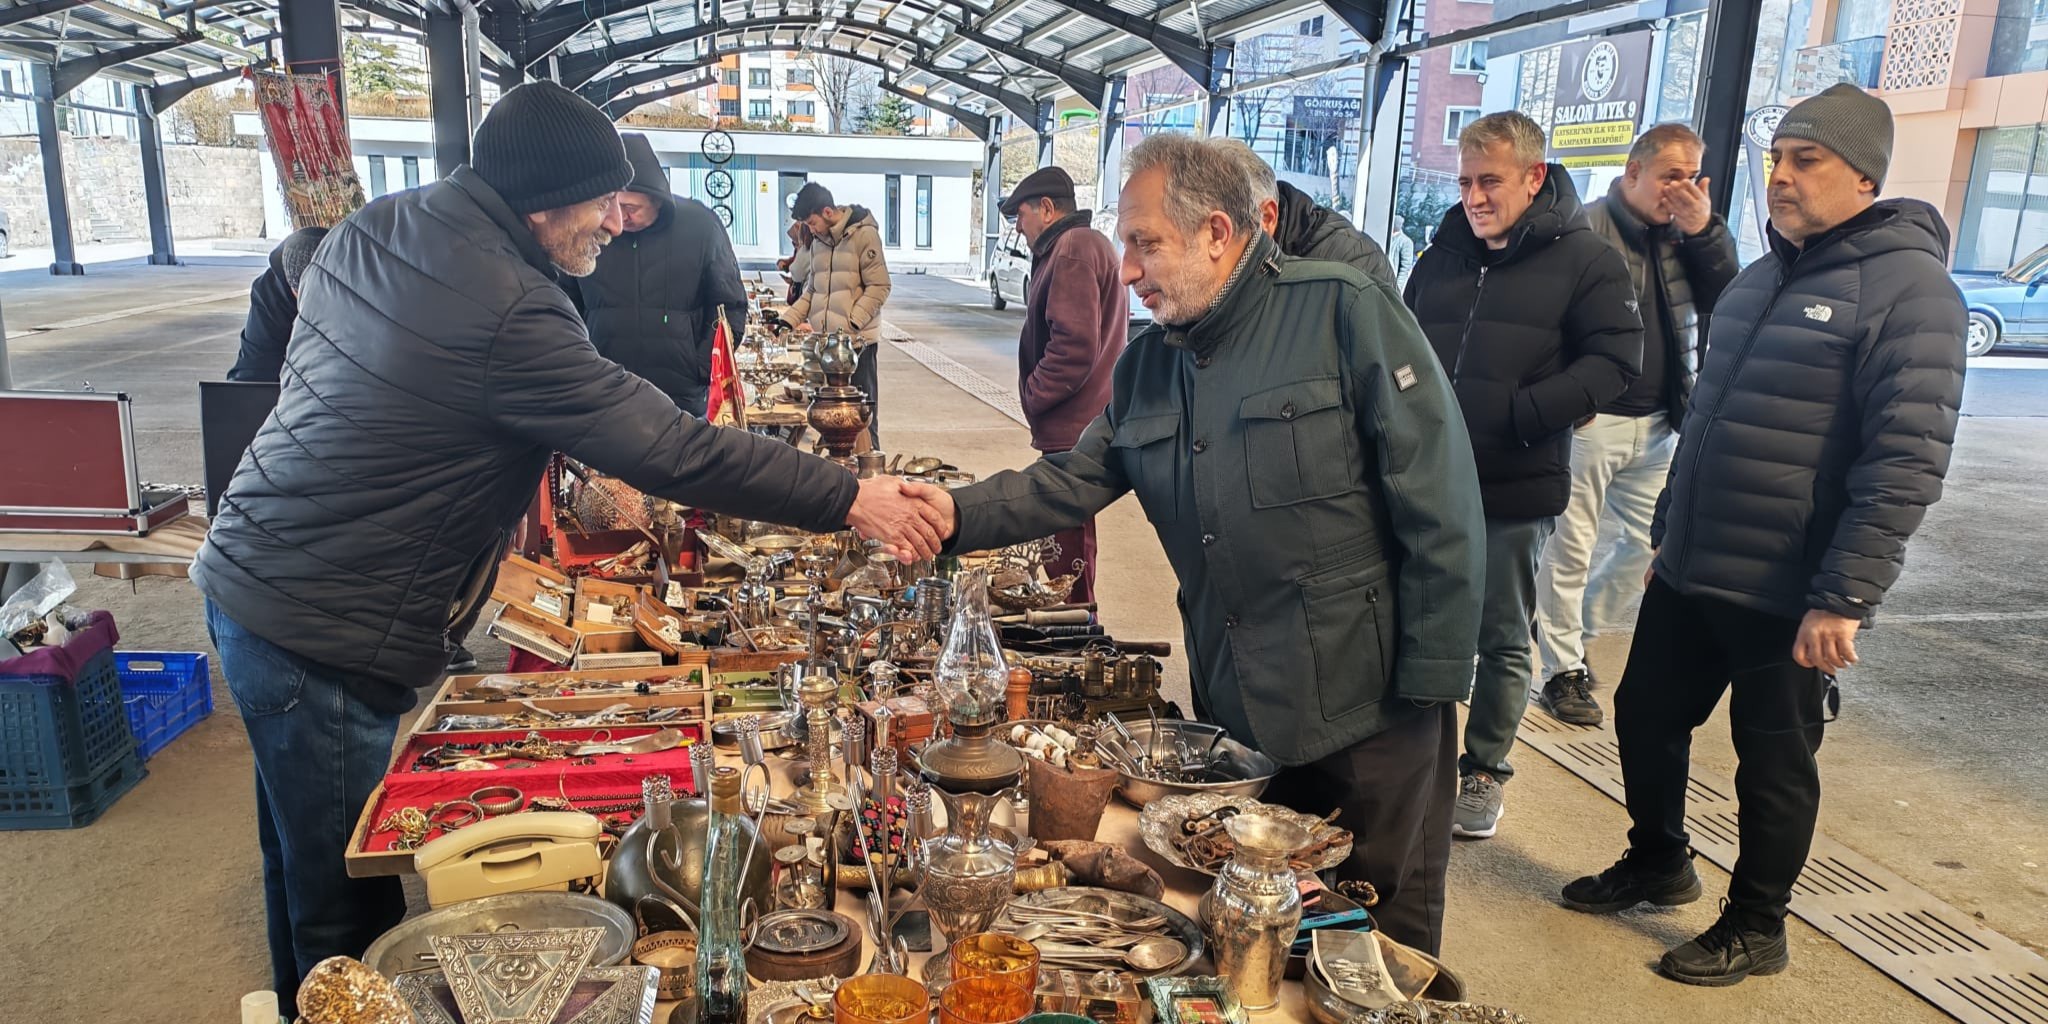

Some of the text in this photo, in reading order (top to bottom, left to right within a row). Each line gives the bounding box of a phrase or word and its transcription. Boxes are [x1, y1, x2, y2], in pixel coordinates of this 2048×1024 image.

[1555, 101, 1637, 124] SALON MYK 9
[1617, 124, 1632, 132] TEK
